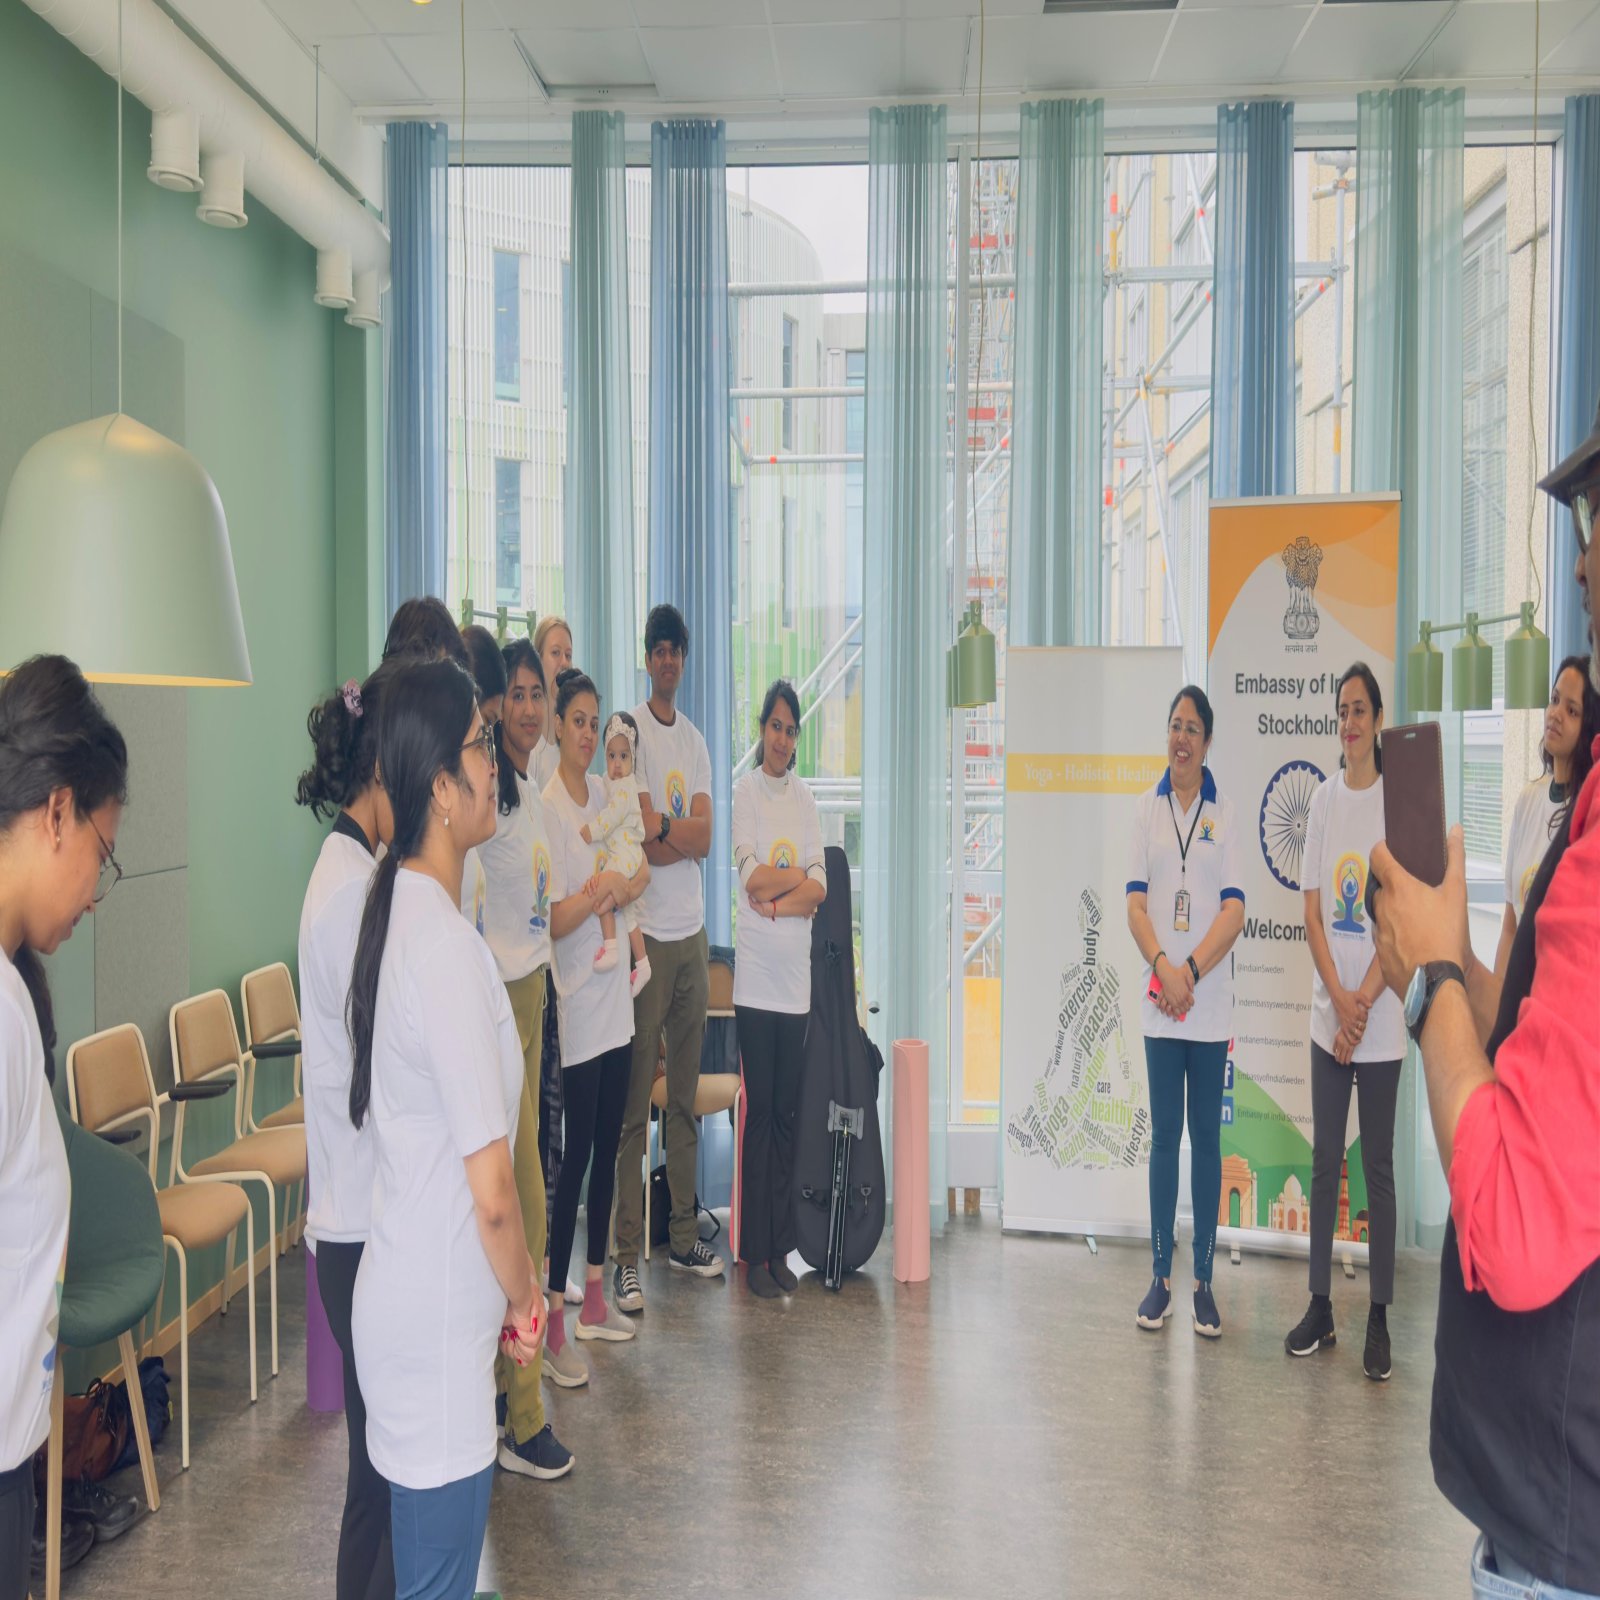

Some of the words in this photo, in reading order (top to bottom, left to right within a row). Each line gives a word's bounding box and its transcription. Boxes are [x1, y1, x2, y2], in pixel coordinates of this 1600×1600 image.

[1235, 673, 1305, 699] Embassy
[1309, 673, 1326, 694] of
[1024, 763, 1053, 787] Yoga
[1065, 763, 1113, 783] Holistic
[1117, 764, 1161, 784] Healin
[1081, 889, 1102, 927] energy
[1083, 928, 1099, 965] body
[1243, 918, 1307, 941] Welcom
[1059, 969, 1097, 1029] exercise
[1079, 968, 1120, 1058] peaceful
[1100, 1015, 1119, 1042] vitality
[1054, 1030, 1065, 1066] workout
[1070, 1047, 1105, 1122] relaxation
[1071, 1047, 1083, 1088] natural
[1034, 1082, 1048, 1113] pose
[1096, 1081, 1111, 1094] care
[1043, 1095, 1070, 1146] yoga
[1091, 1094, 1132, 1133] healthy
[1286, 1114, 1313, 1124] Stockhol
[1008, 1122, 1032, 1149] strength
[1029, 1115, 1054, 1158] fitness
[1058, 1130, 1087, 1166] health
[1082, 1118, 1120, 1158] meditation
[1123, 1108, 1147, 1167] lifestyle
